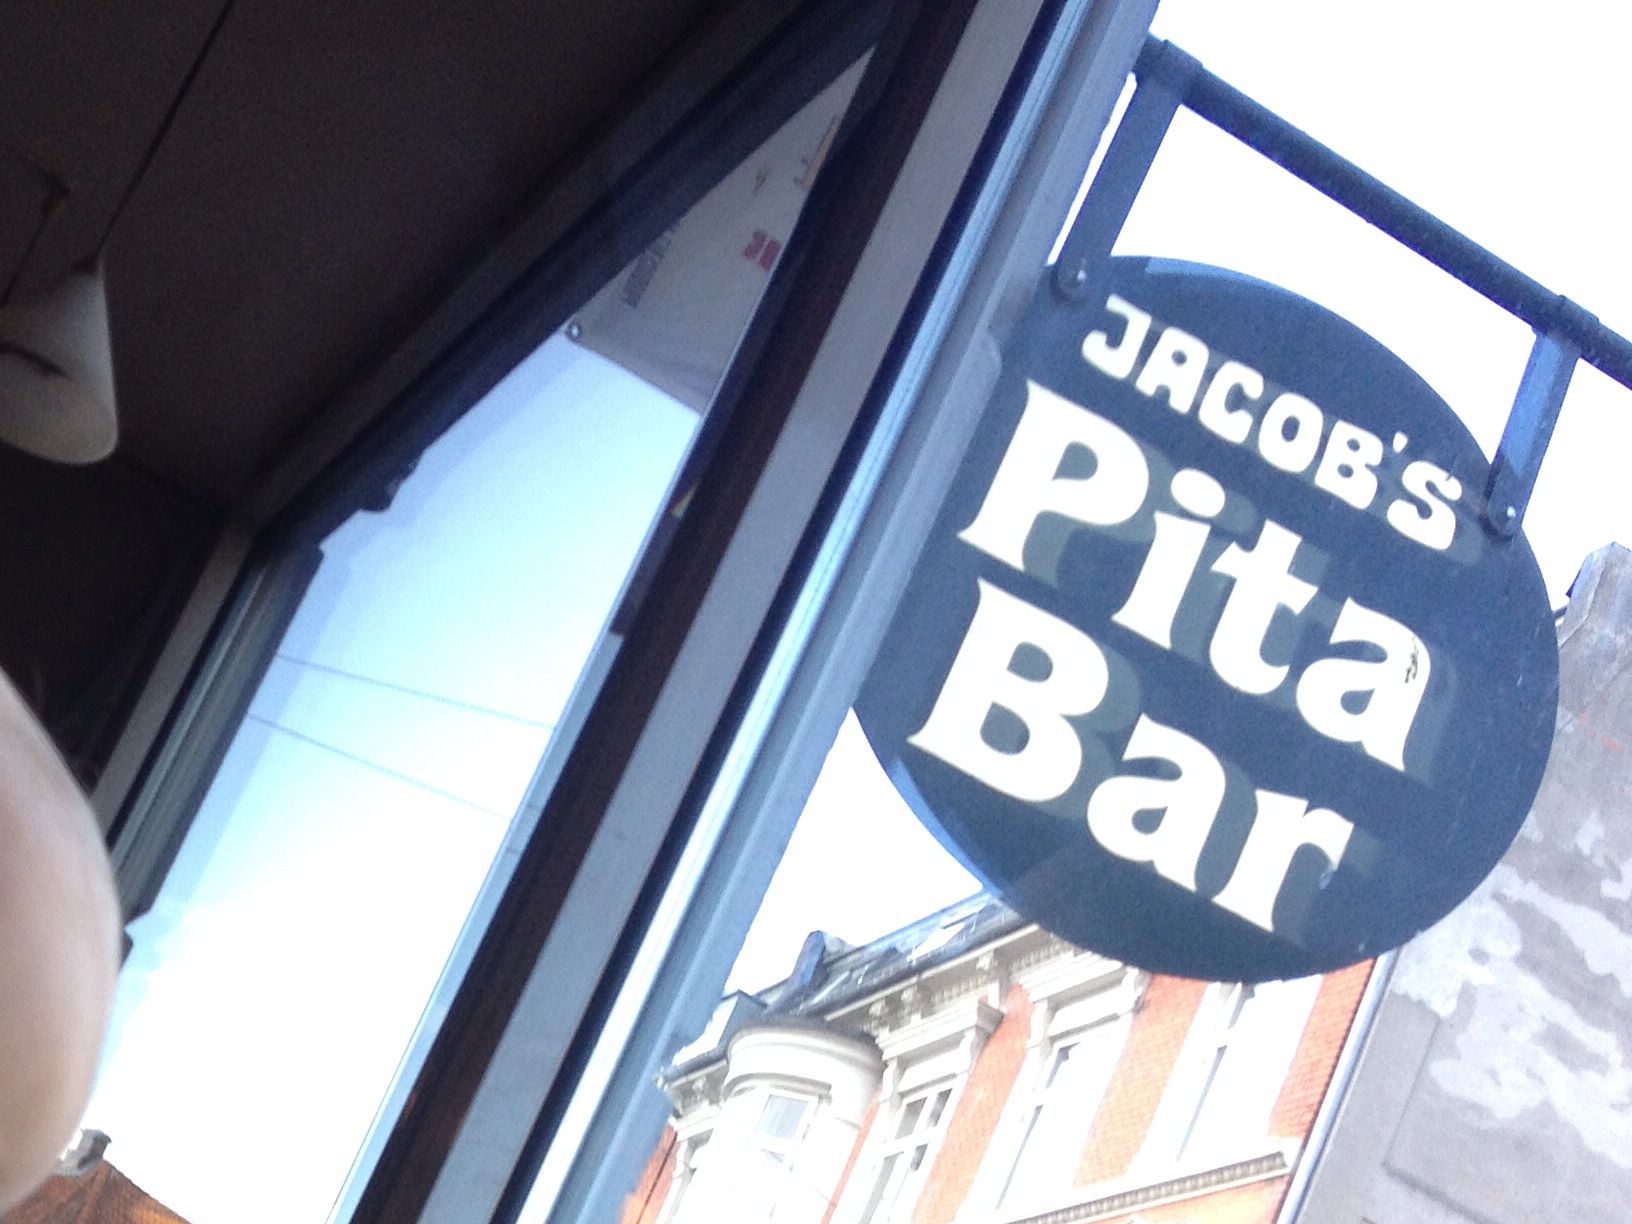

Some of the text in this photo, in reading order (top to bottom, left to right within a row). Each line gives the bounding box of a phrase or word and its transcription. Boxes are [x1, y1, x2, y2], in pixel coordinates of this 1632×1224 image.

[957, 378, 1432, 772] Pita
[1081, 293, 1463, 551] JACOB'S
[907, 577, 1355, 933] Bar
